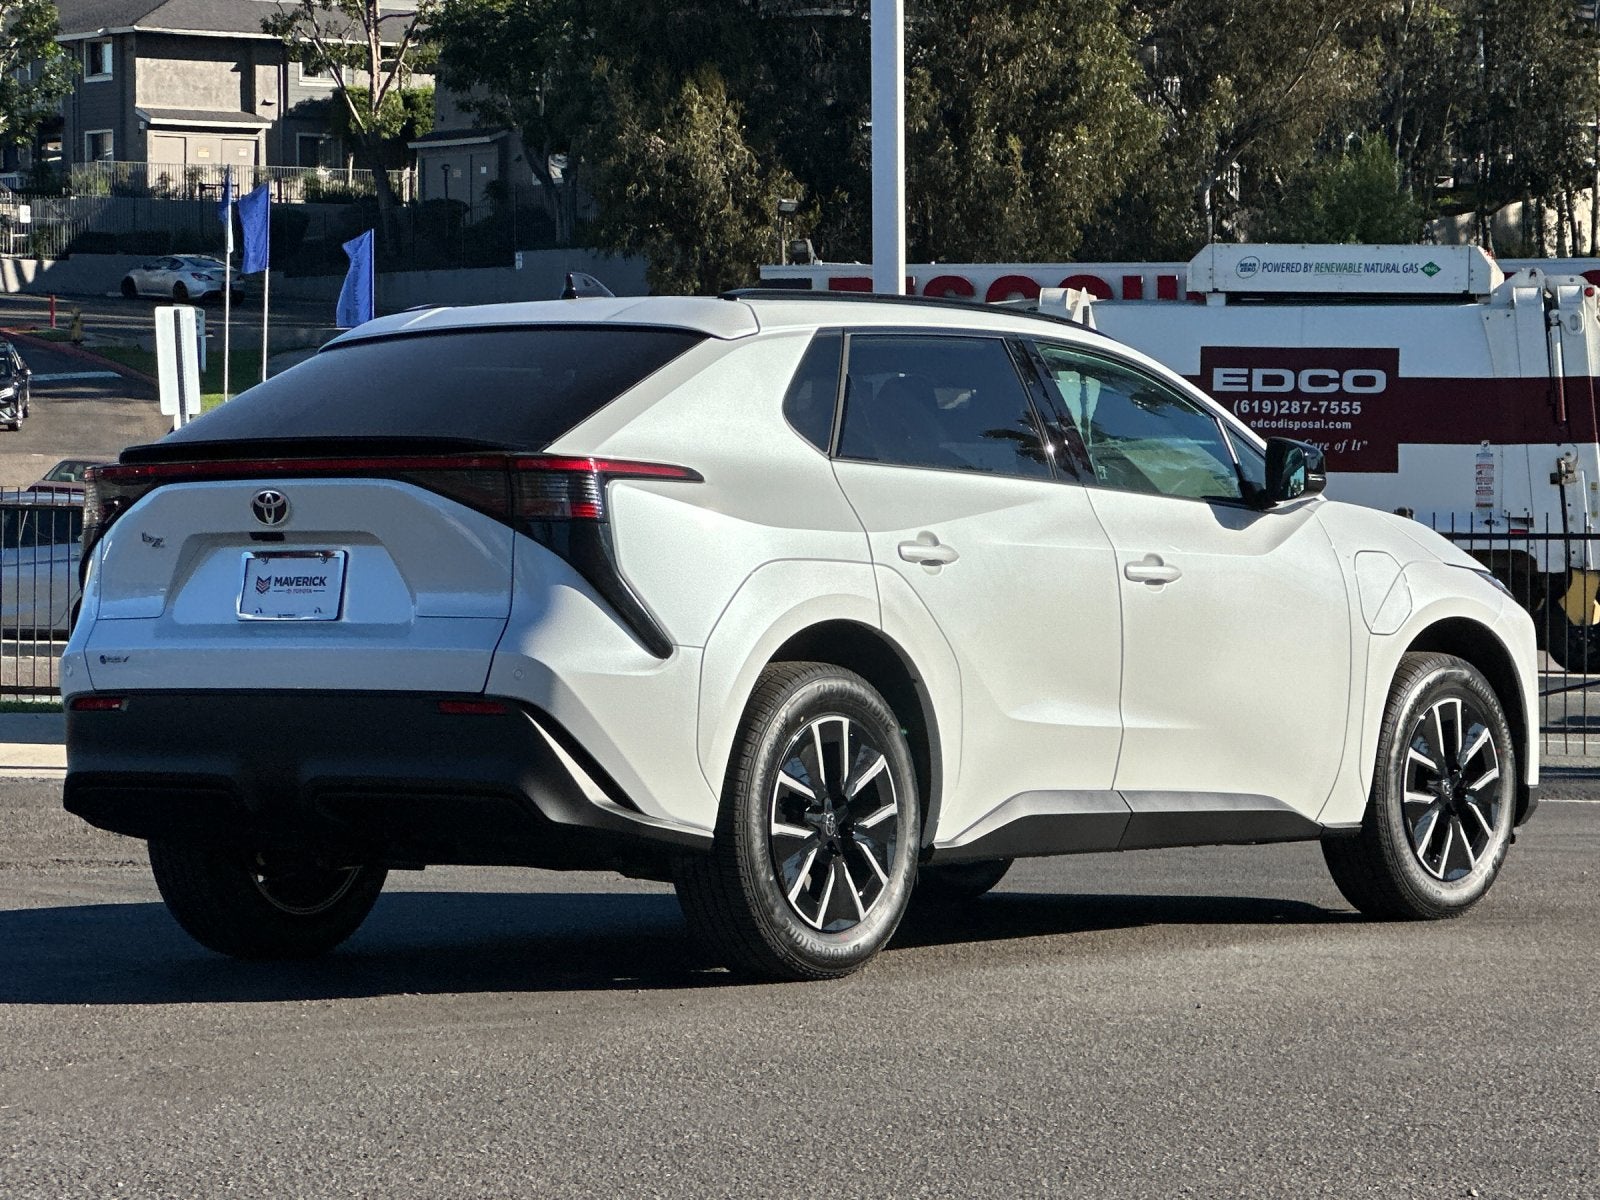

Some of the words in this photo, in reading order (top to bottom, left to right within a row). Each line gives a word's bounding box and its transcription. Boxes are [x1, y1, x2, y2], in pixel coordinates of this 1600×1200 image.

[1261, 262, 1302, 273] POWERED
[1303, 262, 1314, 273] BY
[1314, 262, 1363, 273] RENEWABLE
[1363, 262, 1401, 273] NATURAL
[1402, 262, 1419, 274] GAS
[1212, 367, 1387, 394] EDCO
[1233, 399, 1362, 416] (619)287-7555
[1250, 418, 1352, 430] edcodisposal.com
[1334, 439, 1347, 453] of
[273, 575, 328, 587] MAVERICK
